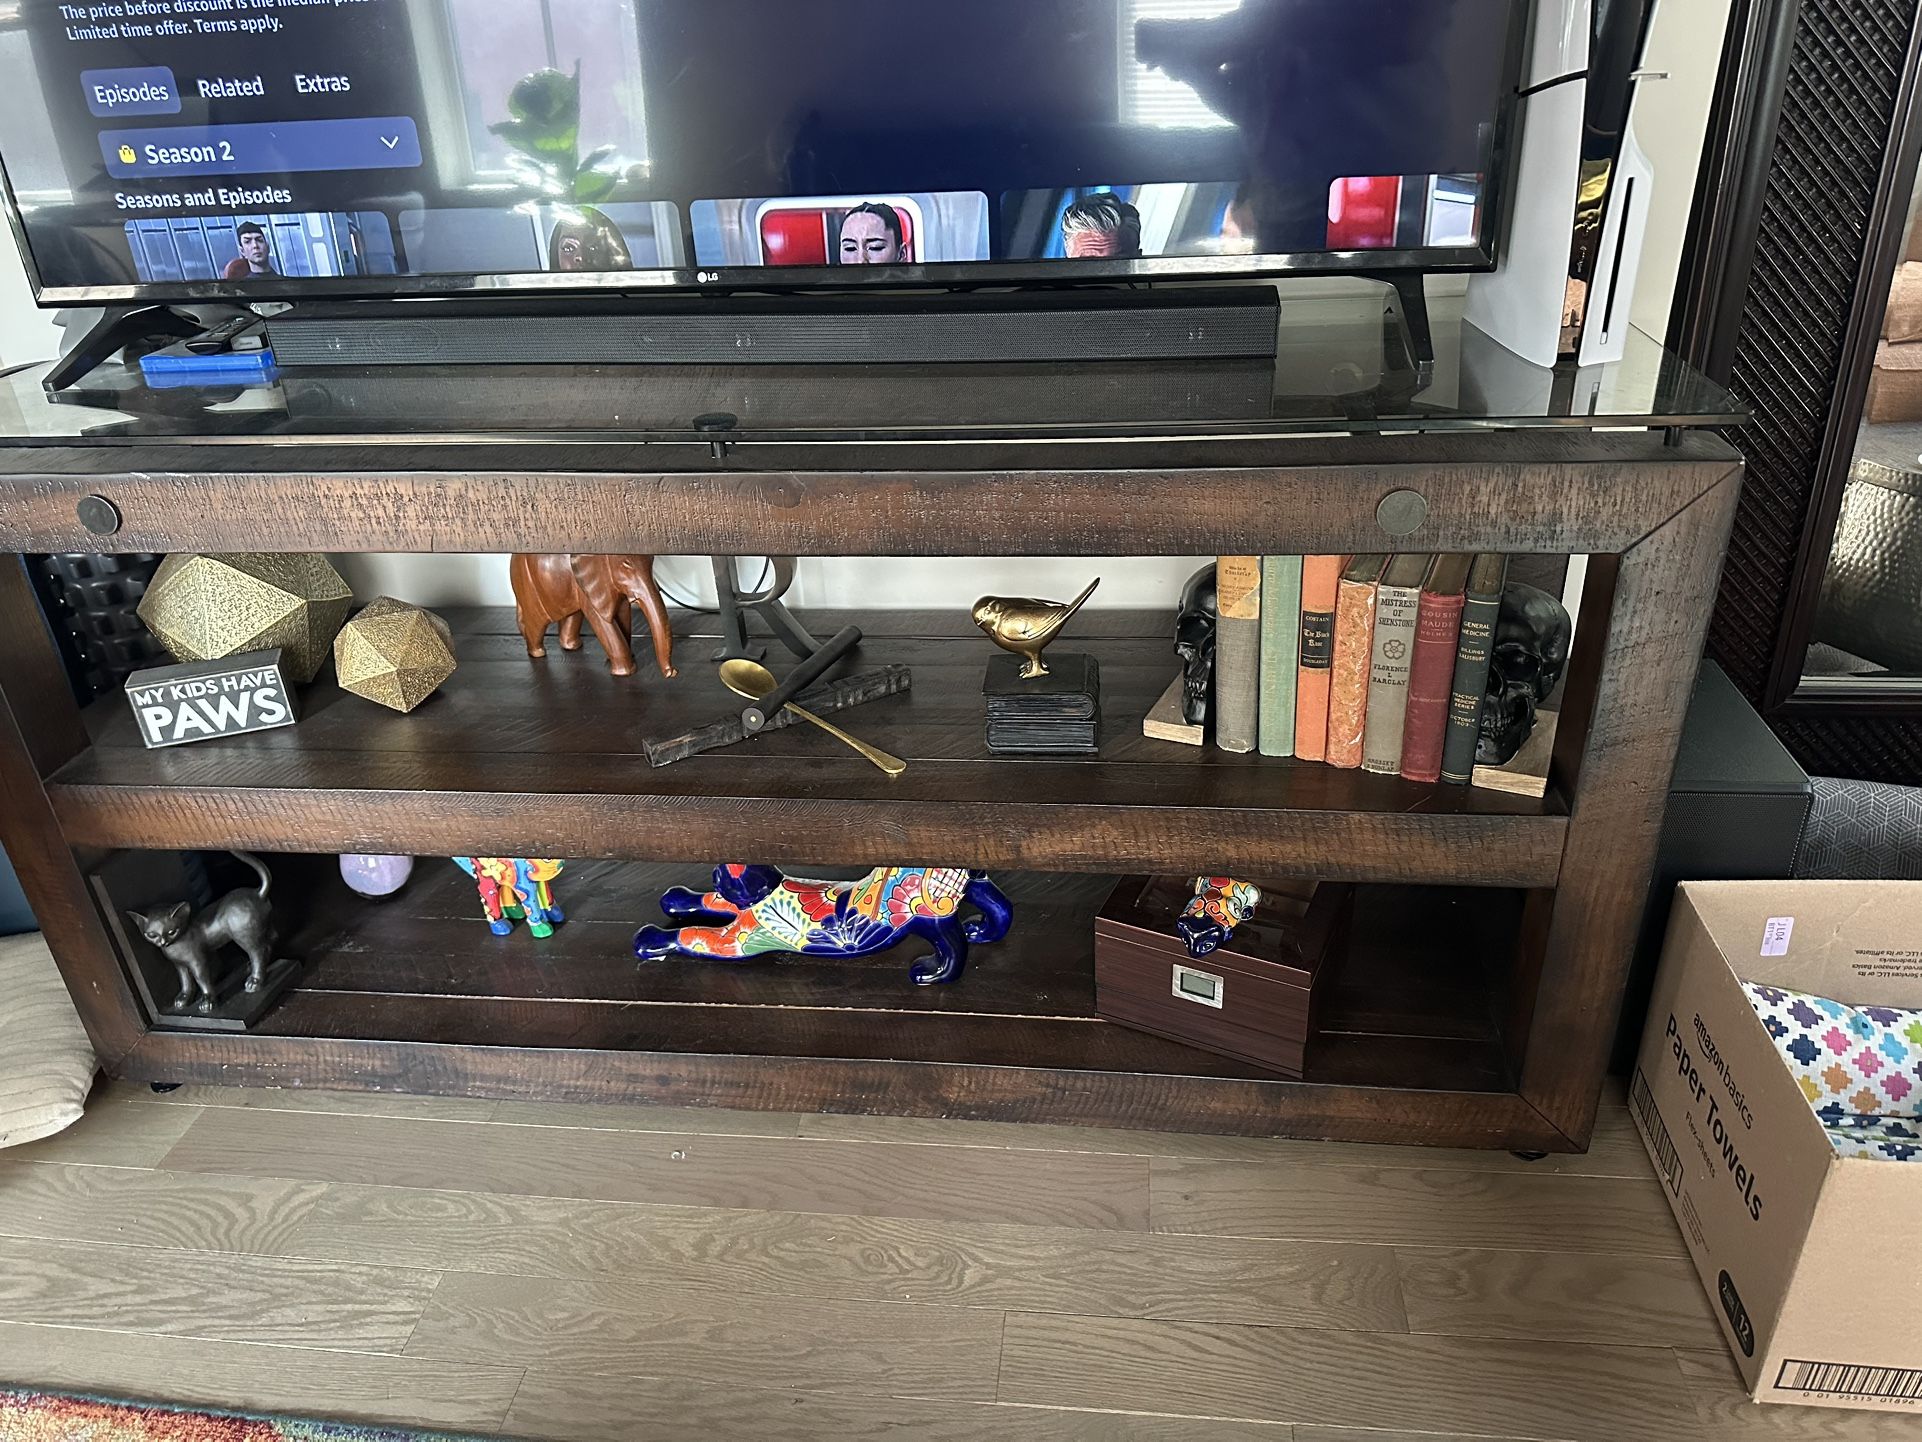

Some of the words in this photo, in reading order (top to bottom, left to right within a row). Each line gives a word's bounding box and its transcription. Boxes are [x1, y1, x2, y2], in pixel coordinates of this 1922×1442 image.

[59, 4, 87, 19] The
[89, 2, 123, 21] price
[124, 0, 171, 16] before
[173, 0, 233, 13] discount
[66, 23, 119, 40] Limited
[120, 22, 153, 38] time
[155, 20, 192, 36] offer.
[193, 19, 237, 33] Terms
[240, 14, 283, 34] apply.
[197, 76, 265, 98] Related
[295, 74, 351, 93] Extras
[93, 82, 169, 108] Episodes
[145, 144, 217, 165] Season
[218, 140, 235, 161] 2
[115, 192, 182, 209] Seasons
[184, 188, 216, 207] and
[218, 186, 292, 209] Episodes
[707, 272, 719, 281] LG
[1393, 590, 1407, 598] THE
[1380, 598, 1417, 608] MISTRESS
[1393, 609, 1403, 617] OF
[1421, 610, 1458, 618] COUSIN
[1378, 617, 1416, 628] SHENSTONE
[1421, 620, 1455, 628] MAUDE
[1463, 621, 1490, 630] GENERAL
[1461, 628, 1490, 637] MEDICINE
[1373, 663, 1408, 673] FLORENCE
[1372, 677, 1407, 686] BARCLAY
[133, 687, 165, 707] MY
[170, 679, 219, 701] KIDS
[222, 670, 277, 692] HAVE
[141, 687, 286, 743] PAWS
[1666, 1012, 1706, 1103] Paper
[1706, 1094, 1763, 1221] Towels
